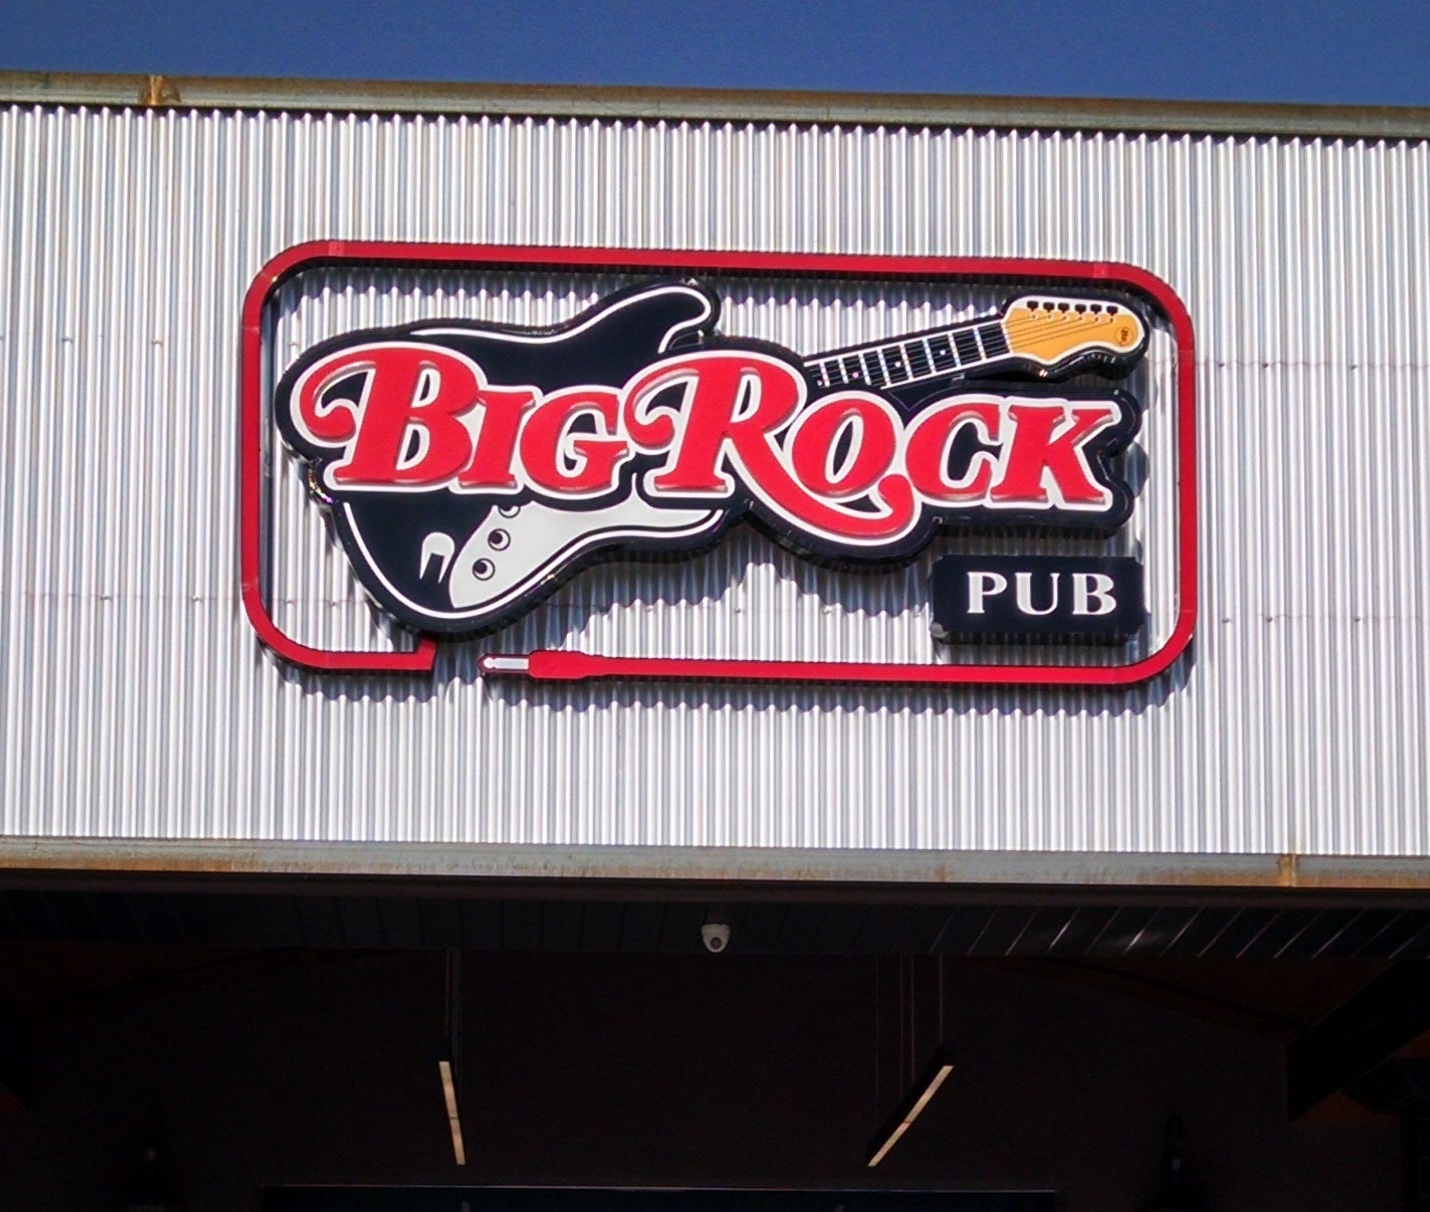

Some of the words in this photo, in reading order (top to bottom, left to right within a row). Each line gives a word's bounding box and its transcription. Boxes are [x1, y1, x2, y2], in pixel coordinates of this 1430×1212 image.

[297, 347, 629, 495] BIG
[627, 349, 1119, 537] ROCK
[966, 572, 1118, 617] PUB
